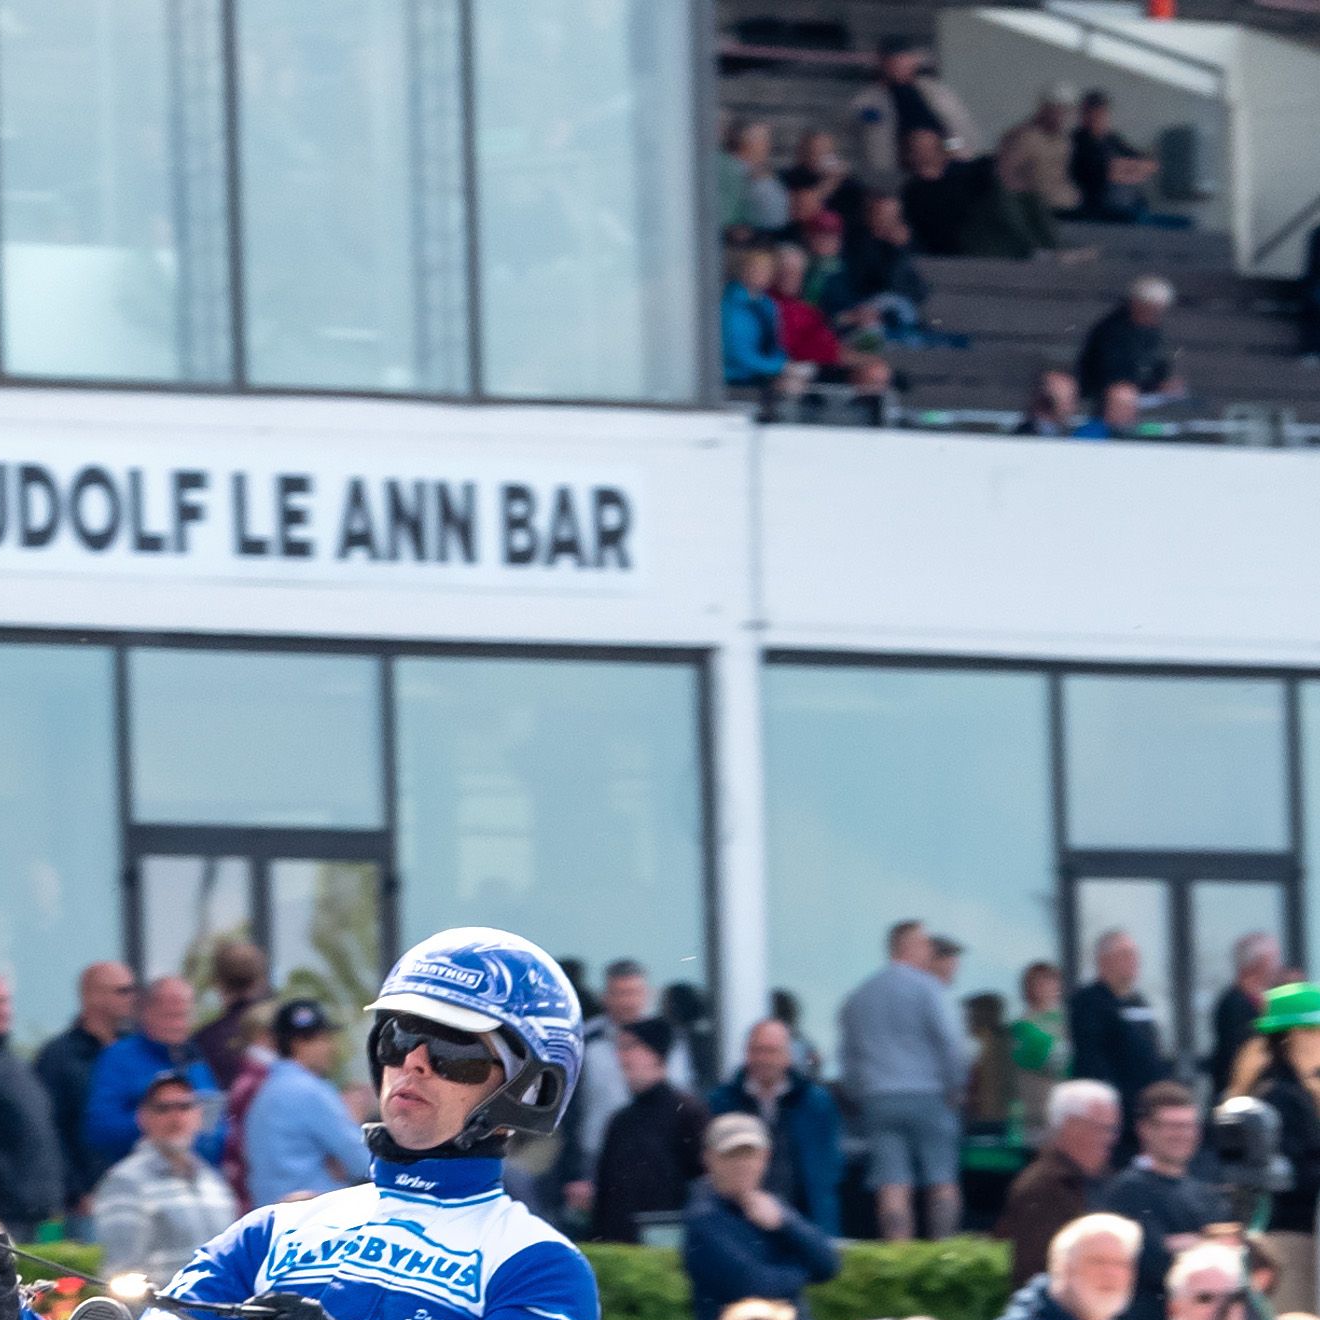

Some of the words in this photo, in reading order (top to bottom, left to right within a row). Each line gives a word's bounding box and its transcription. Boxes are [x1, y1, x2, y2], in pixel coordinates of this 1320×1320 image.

[233, 471, 313, 557] LE
[339, 477, 477, 564] ANN
[501, 483, 632, 570] BAR
